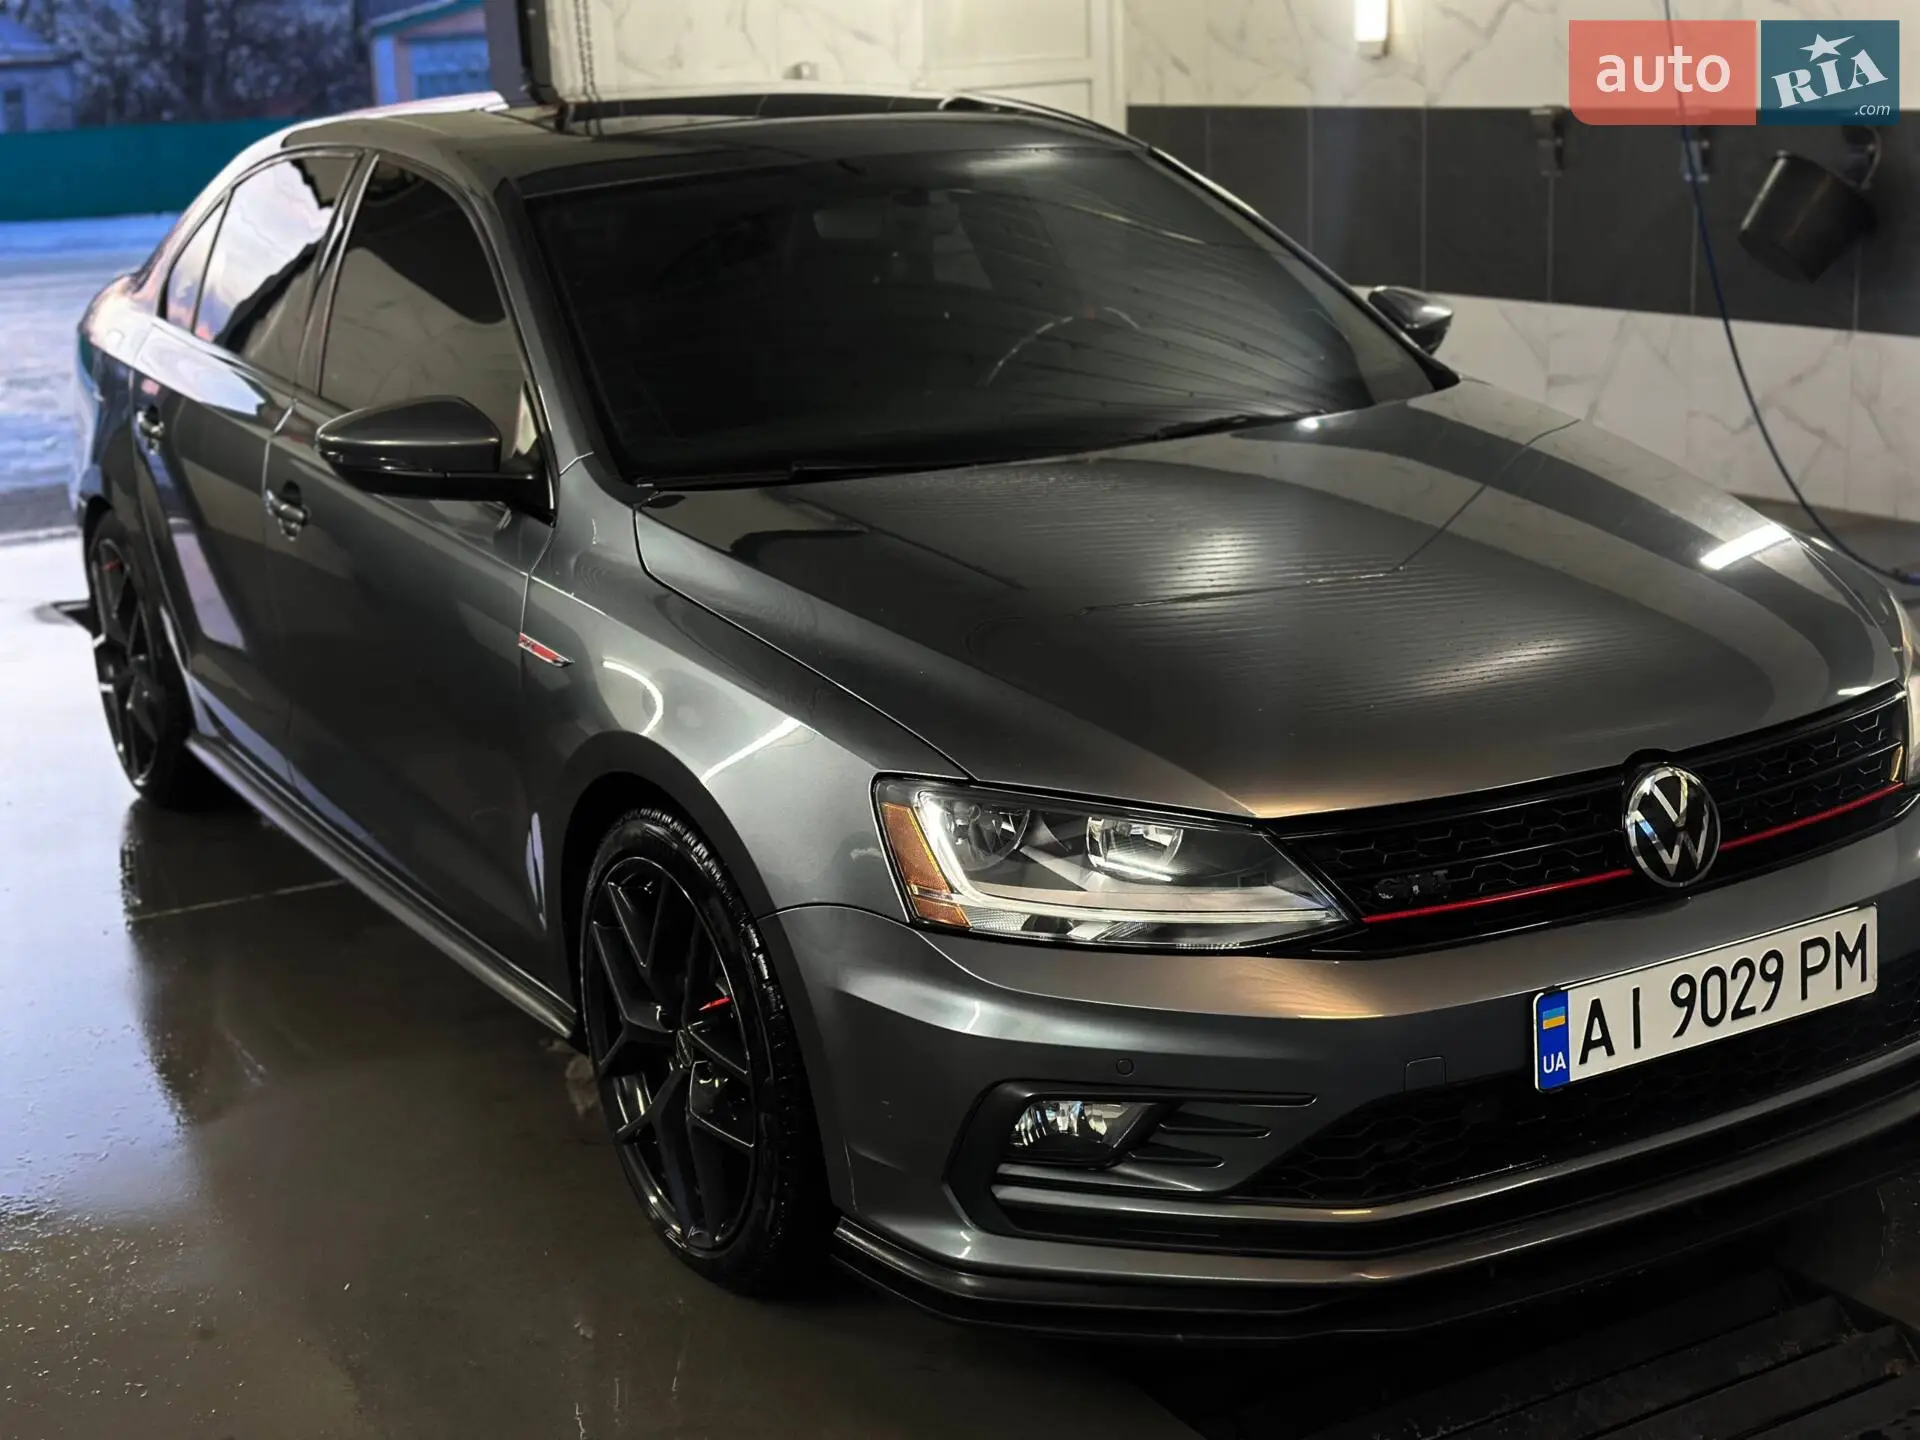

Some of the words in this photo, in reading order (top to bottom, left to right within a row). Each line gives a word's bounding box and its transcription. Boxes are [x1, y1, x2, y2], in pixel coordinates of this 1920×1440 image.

[1578, 985, 1642, 1066] AI
[1669, 948, 1785, 1039] 9029
[1799, 922, 1868, 1001] PM
[1543, 1051, 1567, 1074] UA
